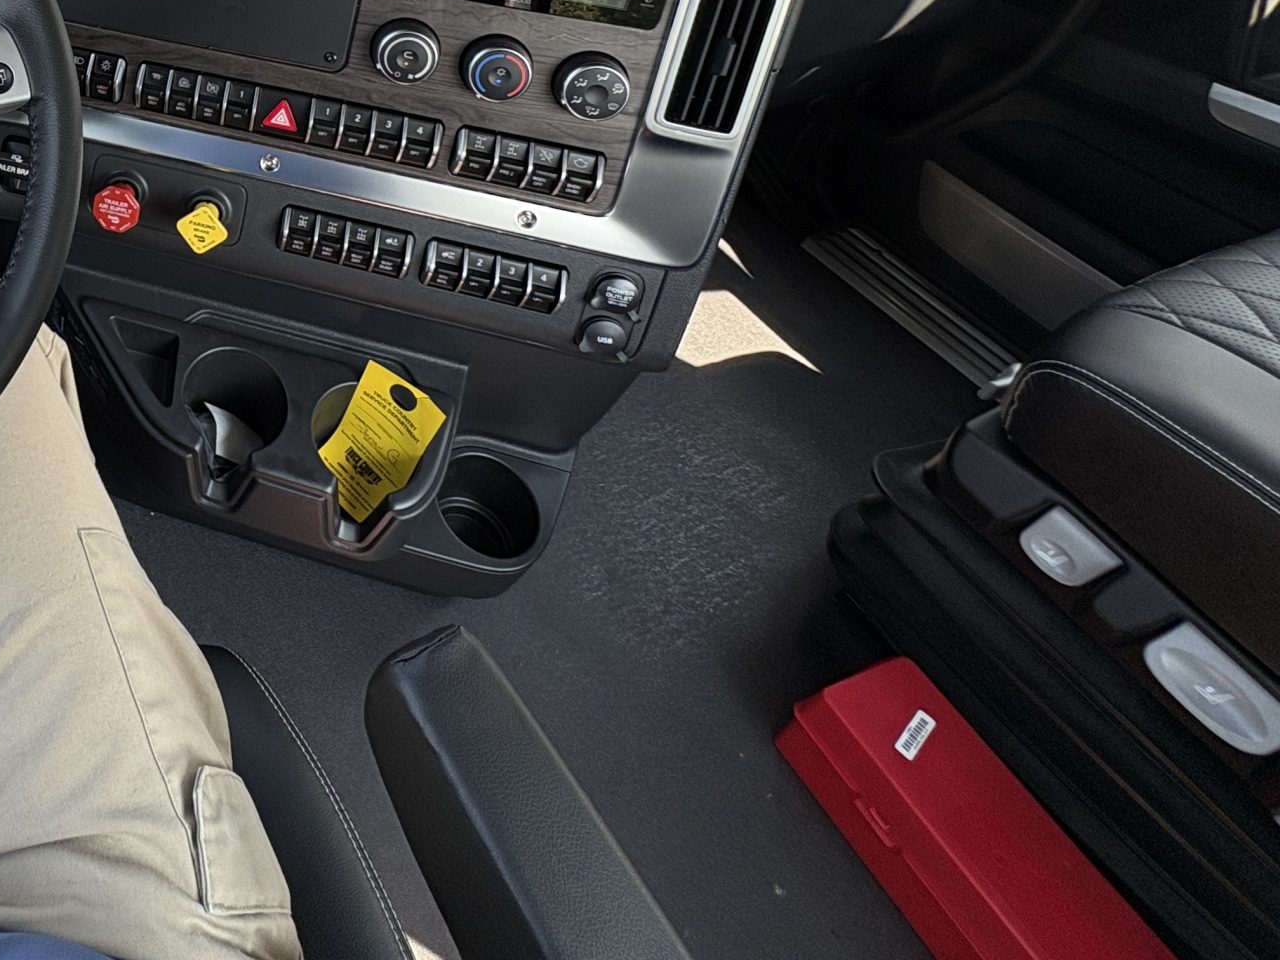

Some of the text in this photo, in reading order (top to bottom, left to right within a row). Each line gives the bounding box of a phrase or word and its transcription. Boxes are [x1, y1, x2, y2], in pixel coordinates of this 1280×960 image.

[325, 107, 331, 116] 1
[354, 114, 362, 123] 2
[385, 120, 393, 129] 3
[416, 126, 424, 135] 4
[16, 167, 30, 176] BRA
[104, 198, 129, 208] TRAILER
[110, 205, 133, 215] SUPPLY
[188, 220, 216, 231] PARKING
[476, 258, 483, 267] 2
[508, 266, 516, 275] 3
[540, 273, 548, 282] 4
[606, 286, 635, 297] POWER
[605, 292, 634, 302] OUTLET
[597, 335, 613, 345] USB
[373, 390, 417, 432] TRUCK COUNTRY
[362, 390, 387, 411] SERVICE
[387, 408, 421, 444] DEPARTMENT
